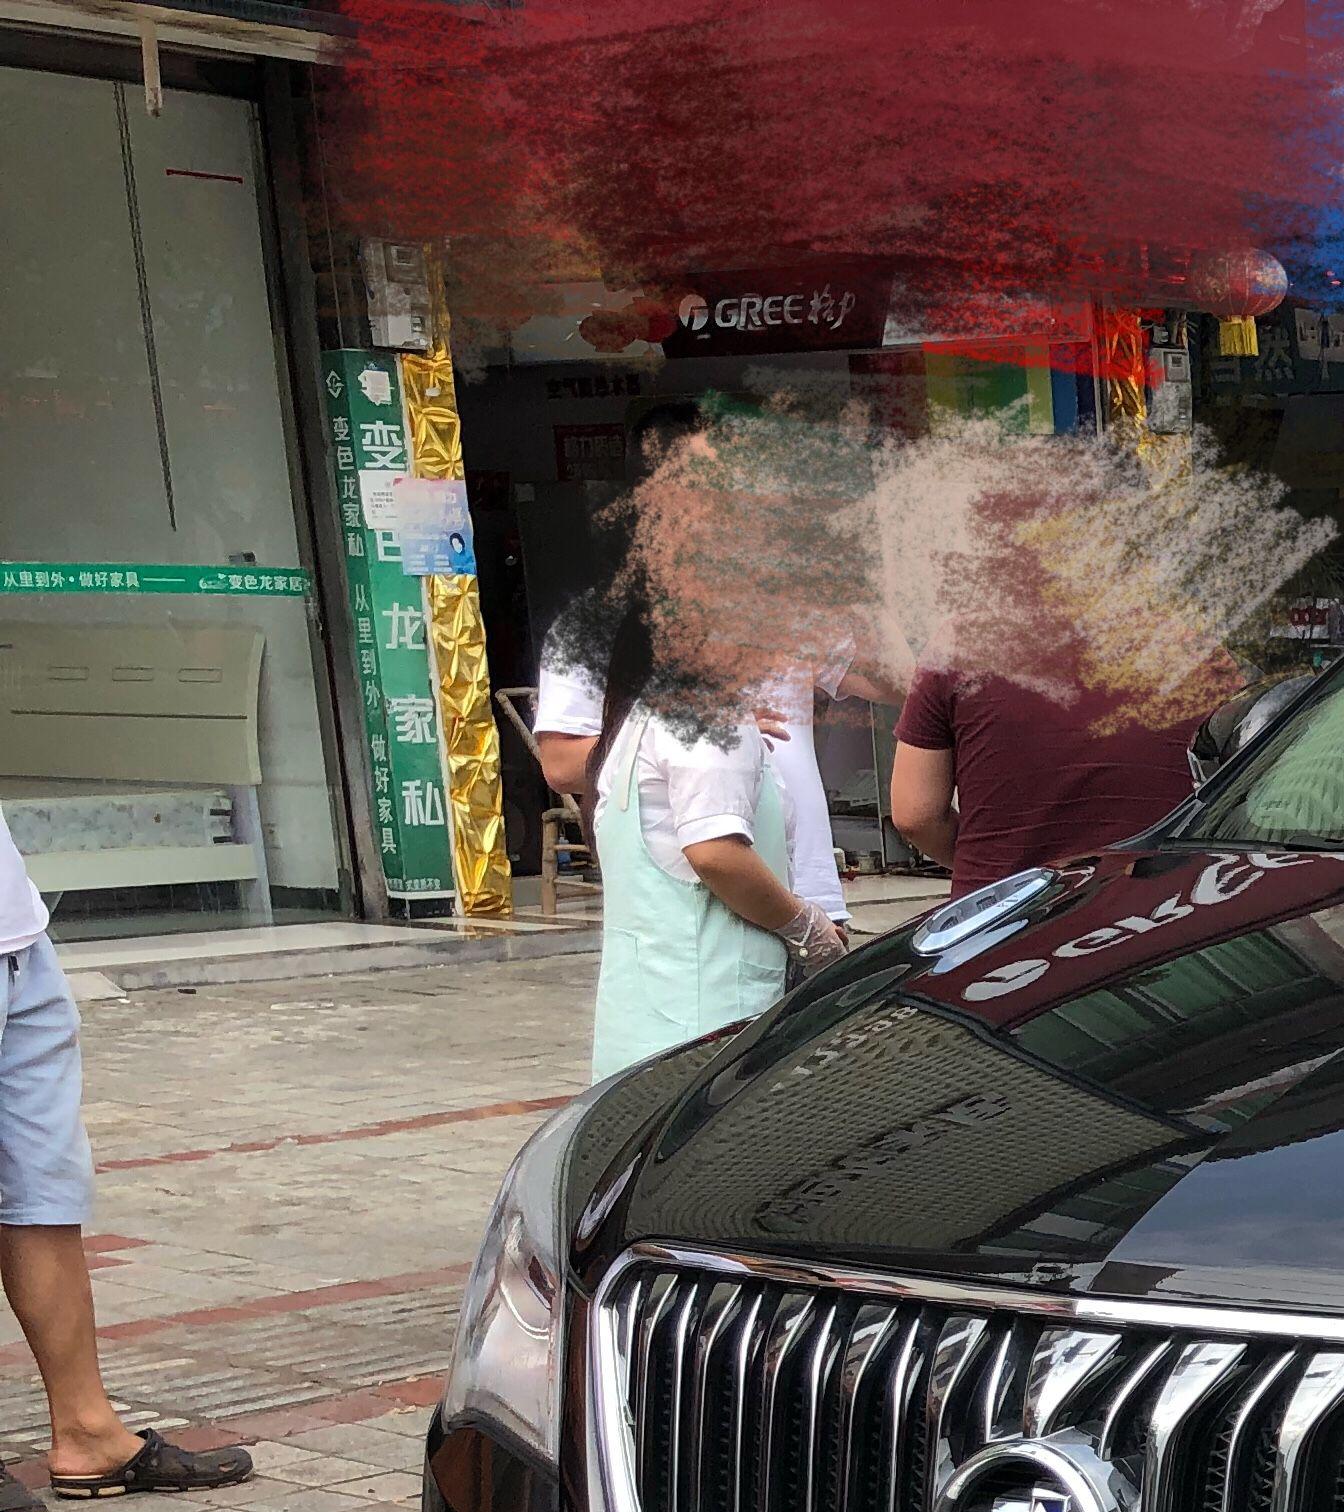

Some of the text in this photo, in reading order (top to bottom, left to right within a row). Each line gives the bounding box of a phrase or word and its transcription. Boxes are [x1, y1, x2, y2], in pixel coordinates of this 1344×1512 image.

[714, 294, 804, 330] GREE
[332, 415, 365, 556] 变色龙家私
[355, 583, 381, 709] 从里到外
[371, 732, 397, 854] 做好家具
